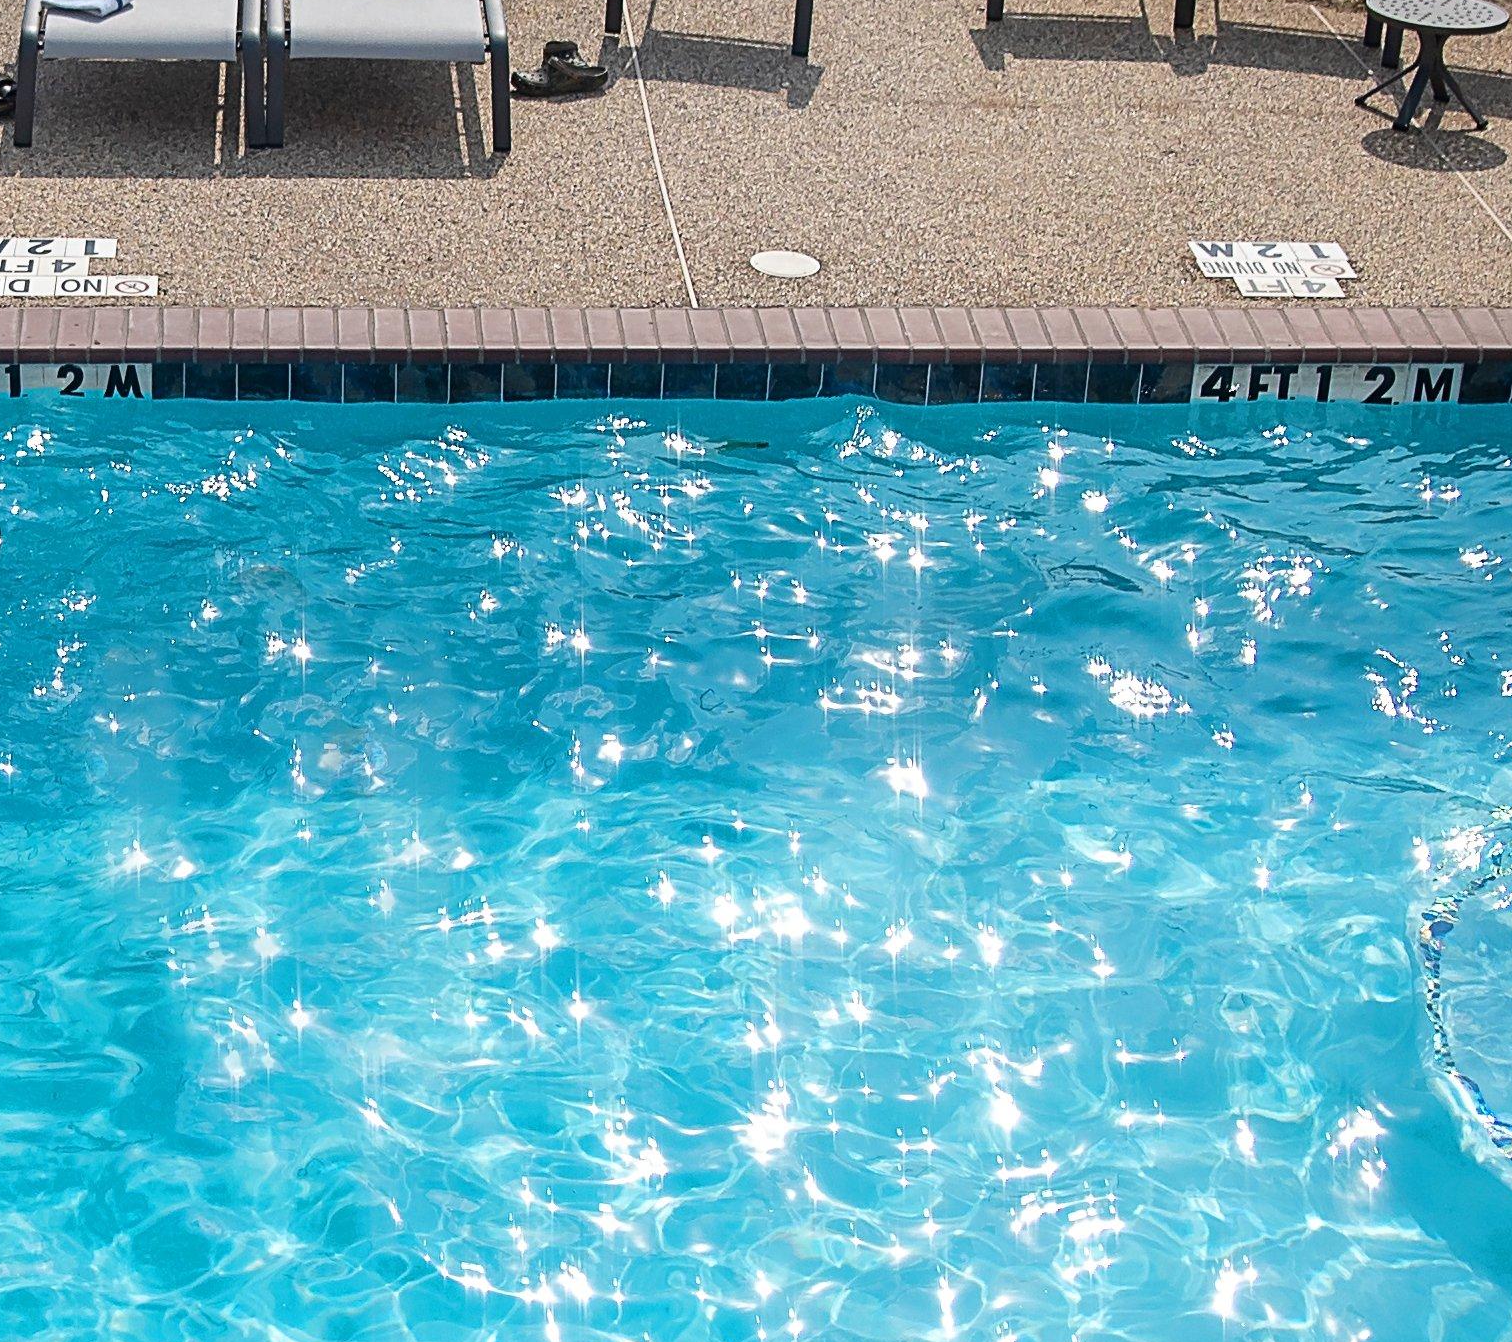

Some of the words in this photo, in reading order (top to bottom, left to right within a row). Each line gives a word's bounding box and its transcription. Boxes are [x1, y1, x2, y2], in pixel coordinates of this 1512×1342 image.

[28, 239, 54, 255] 2
[84, 240, 99, 255] 1
[1197, 243, 1233, 258] M
[1252, 243, 1282, 258] 2
[1308, 244, 1330, 259] 1
[52, 259, 77, 273] 4
[1202, 261, 1267, 274] DIVING
[1272, 261, 1300, 274] NO
[61, 279, 102, 293] NO
[1246, 279, 1287, 293] FT
[1301, 280, 1326, 293] 4
[104, 365, 144, 399] M
[1200, 365, 1237, 403] 4
[1413, 367, 1454, 403] M
